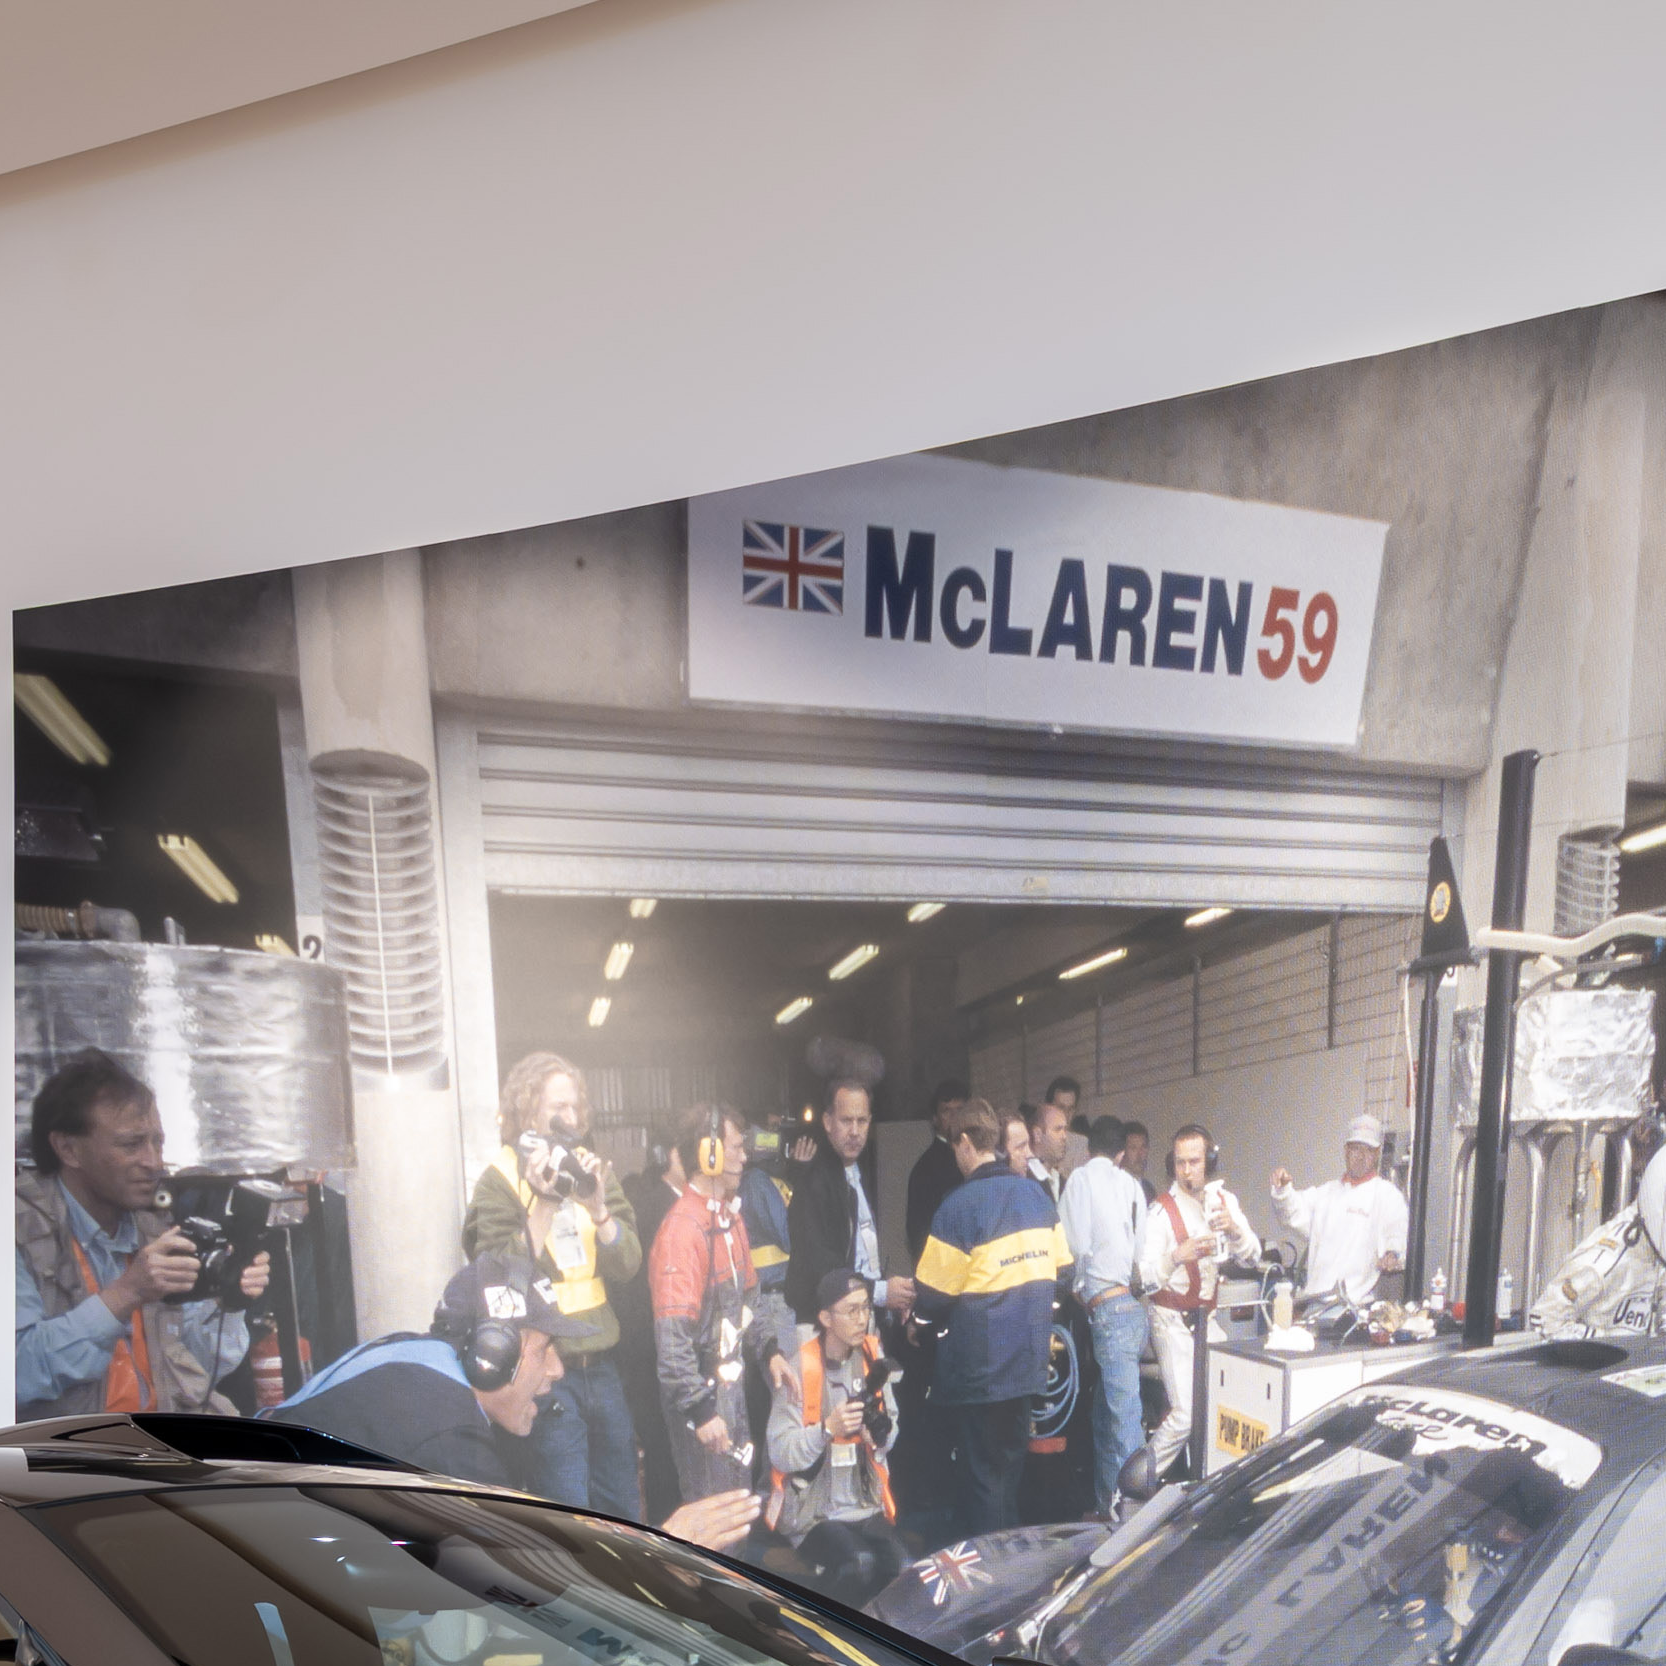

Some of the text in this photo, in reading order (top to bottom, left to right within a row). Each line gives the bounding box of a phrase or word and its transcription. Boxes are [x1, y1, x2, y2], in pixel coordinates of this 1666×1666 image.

[864, 524, 1339, 685] McLAREN 59
[1000, 1249, 1049, 1268] MICHELIN
